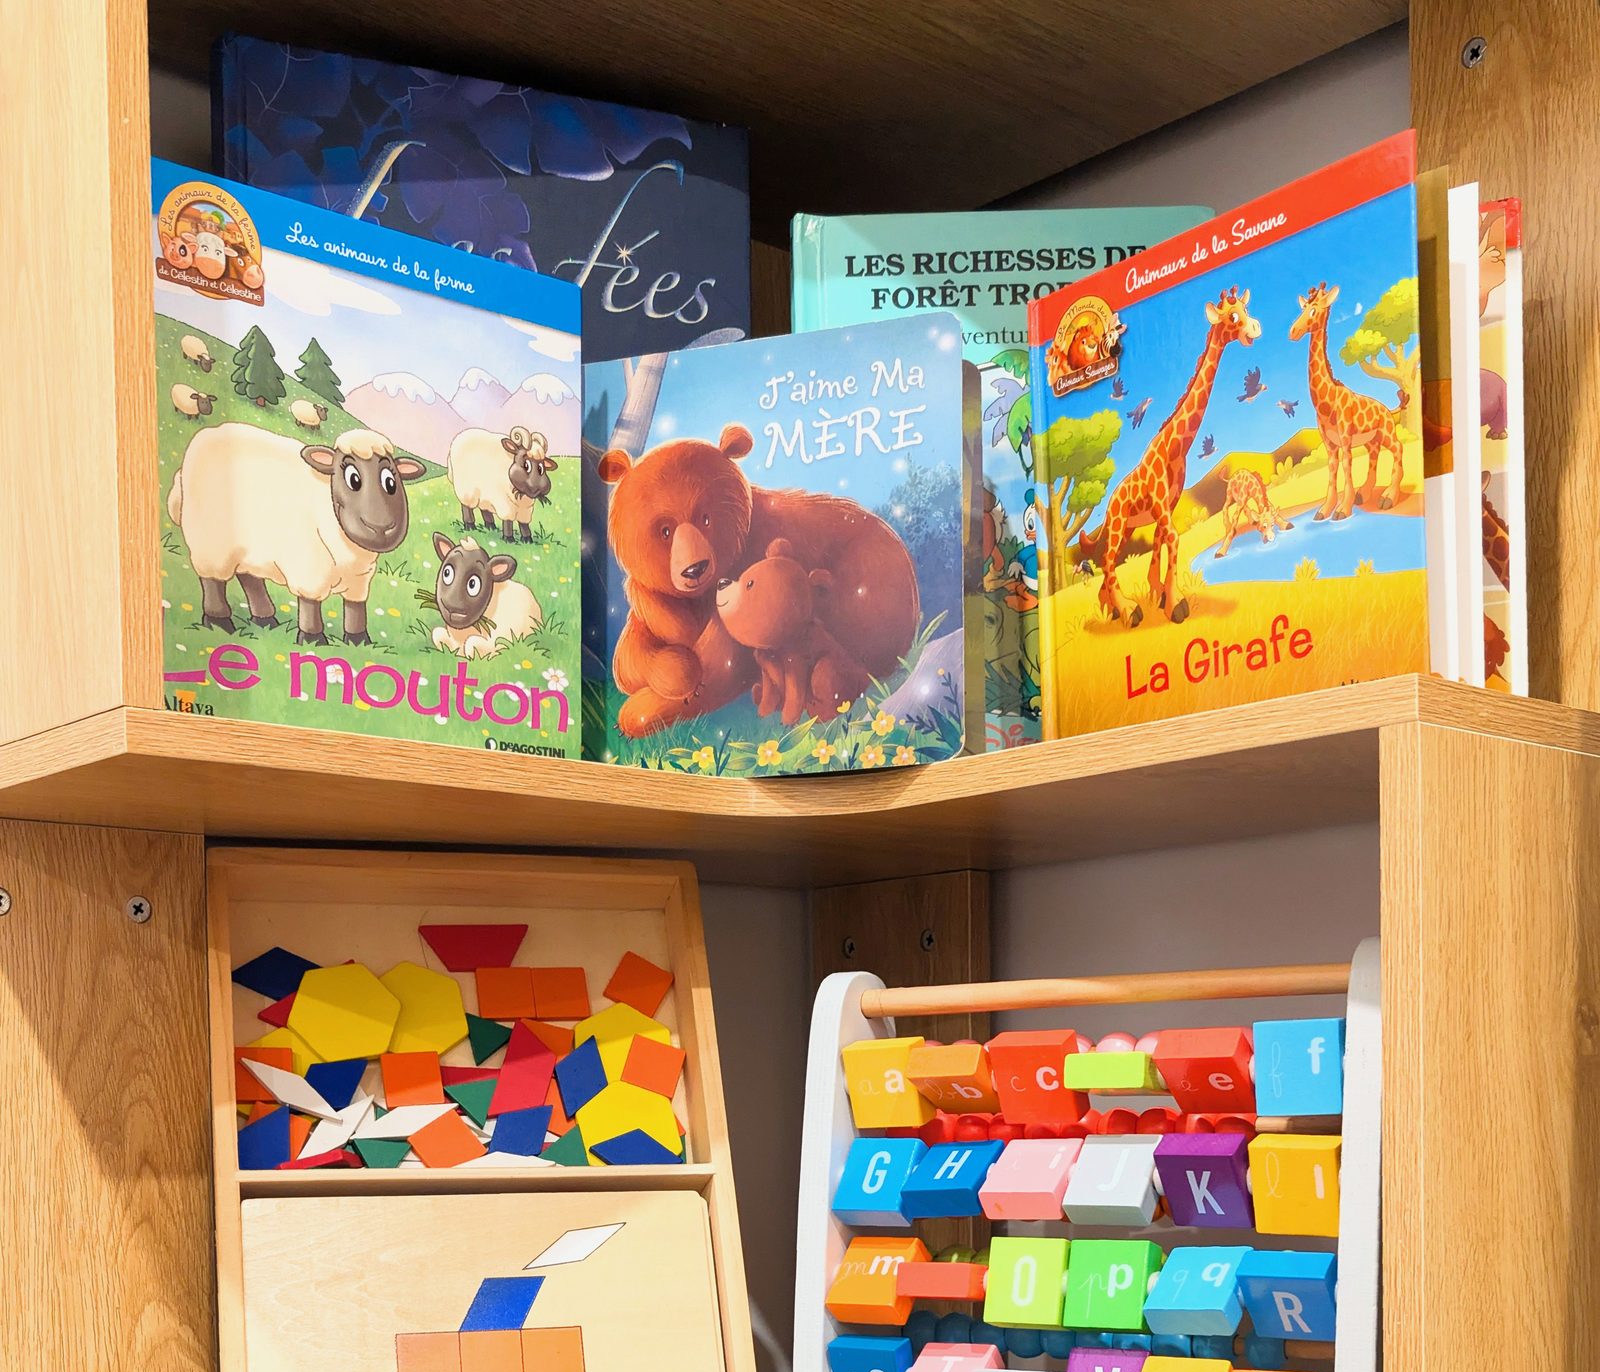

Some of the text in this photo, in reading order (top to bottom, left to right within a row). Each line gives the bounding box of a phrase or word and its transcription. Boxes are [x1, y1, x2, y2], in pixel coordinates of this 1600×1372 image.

[160, 190, 256, 251] Les animaux de la ferme
[285, 221, 475, 294] Les animaux de la ferme
[845, 253, 905, 277] LES
[912, 246, 1096, 278] RICHESSES
[1125, 213, 1287, 294] Animaux de la Savane
[158, 265, 262, 301] de Célestin et Célestine
[871, 279, 986, 310] FORÊT
[1065, 301, 1095, 320] Monde
[759, 357, 926, 410] J'aime Ma
[1056, 362, 1115, 391] Animaux Sauvages
[763, 404, 926, 469] MÈRE
[1125, 614, 1314, 700] La Girafe
[289, 652, 569, 732] mouton
[1307, 1036, 1326, 1075] f
[883, 1068, 905, 1094] a
[951, 1082, 983, 1099] b
[1035, 1066, 1060, 1091] c
[1208, 1072, 1235, 1091] e
[861, 1150, 892, 1195] G
[933, 1150, 973, 1180] H
[1096, 1148, 1131, 1192] J
[1185, 1170, 1226, 1215] K
[869, 1255, 905, 1276] m
[1107, 1264, 1134, 1298] p
[1201, 1262, 1231, 1287] q
[1272, 1291, 1312, 1333] R
